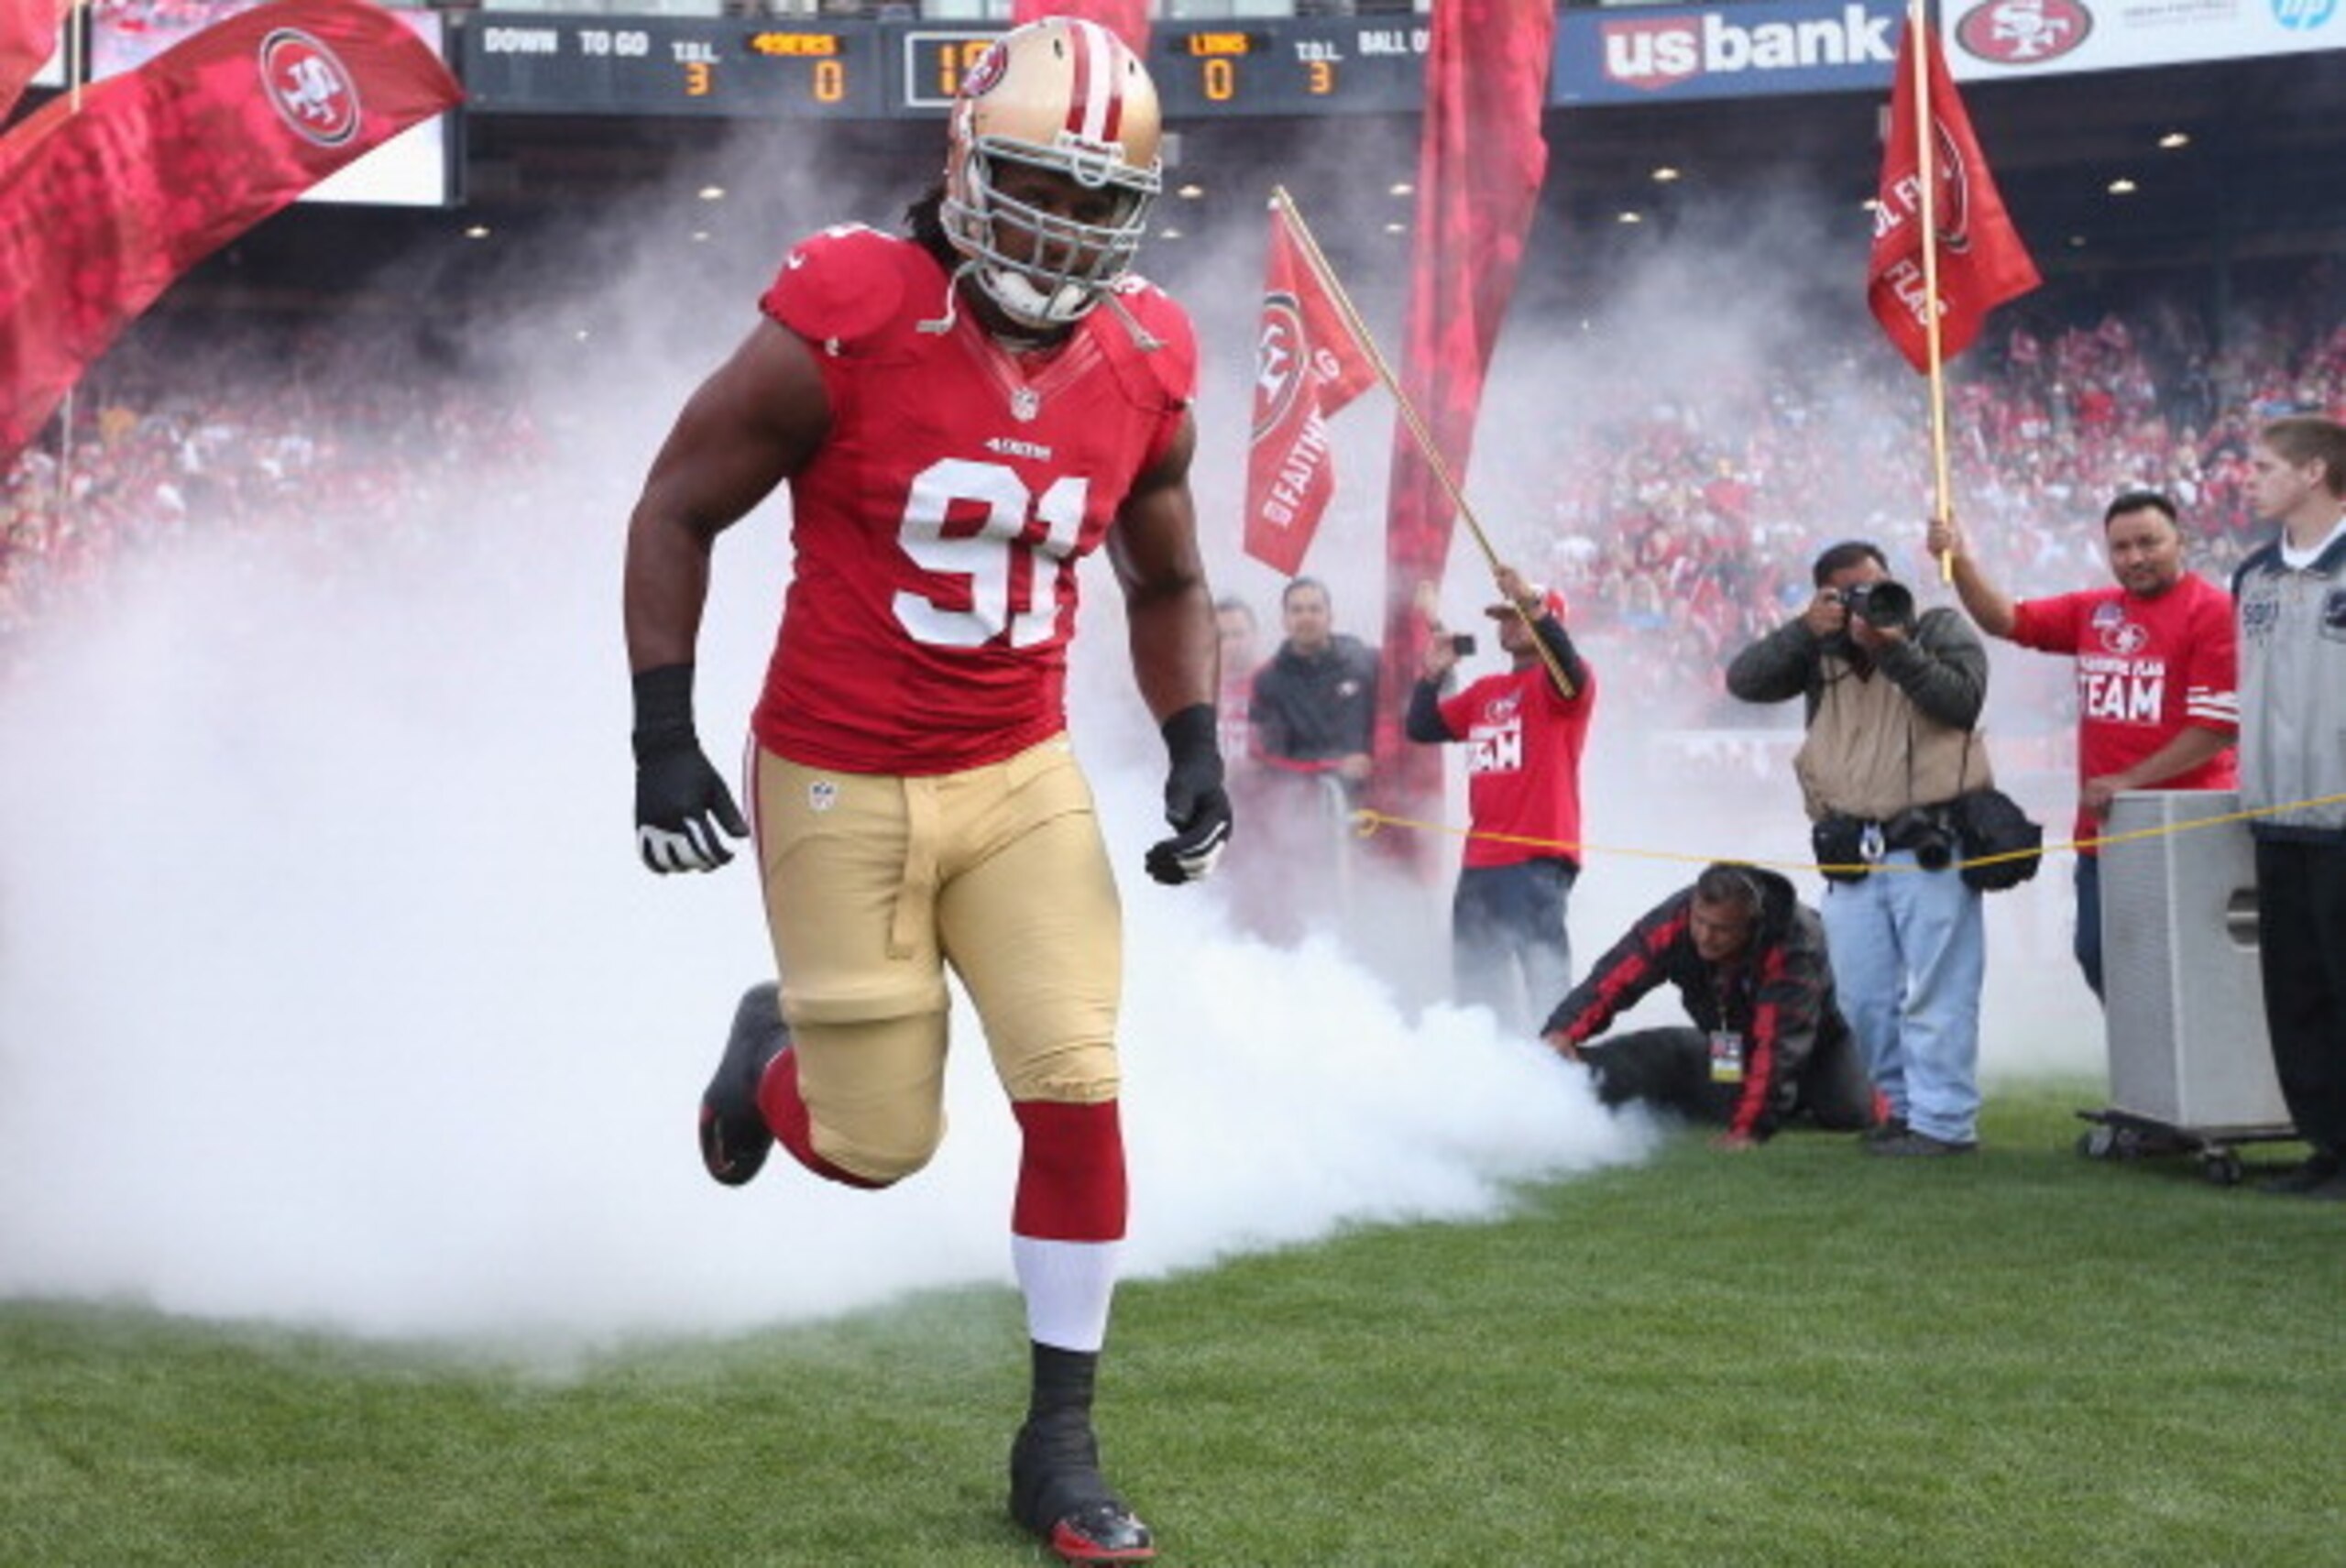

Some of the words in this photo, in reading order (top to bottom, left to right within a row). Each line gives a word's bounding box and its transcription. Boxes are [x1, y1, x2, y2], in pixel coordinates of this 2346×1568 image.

[484, 28, 558, 53] DOWN
[579, 31, 610, 56] TO
[615, 31, 649, 56] GO
[1357, 30, 1407, 54] BALL
[1411, 27, 1432, 52] O
[686, 62, 709, 95] 3
[816, 60, 843, 102] 0
[1204, 59, 1233, 100] 0
[1310, 61, 1331, 93] 3
[892, 457, 1091, 648] 91
